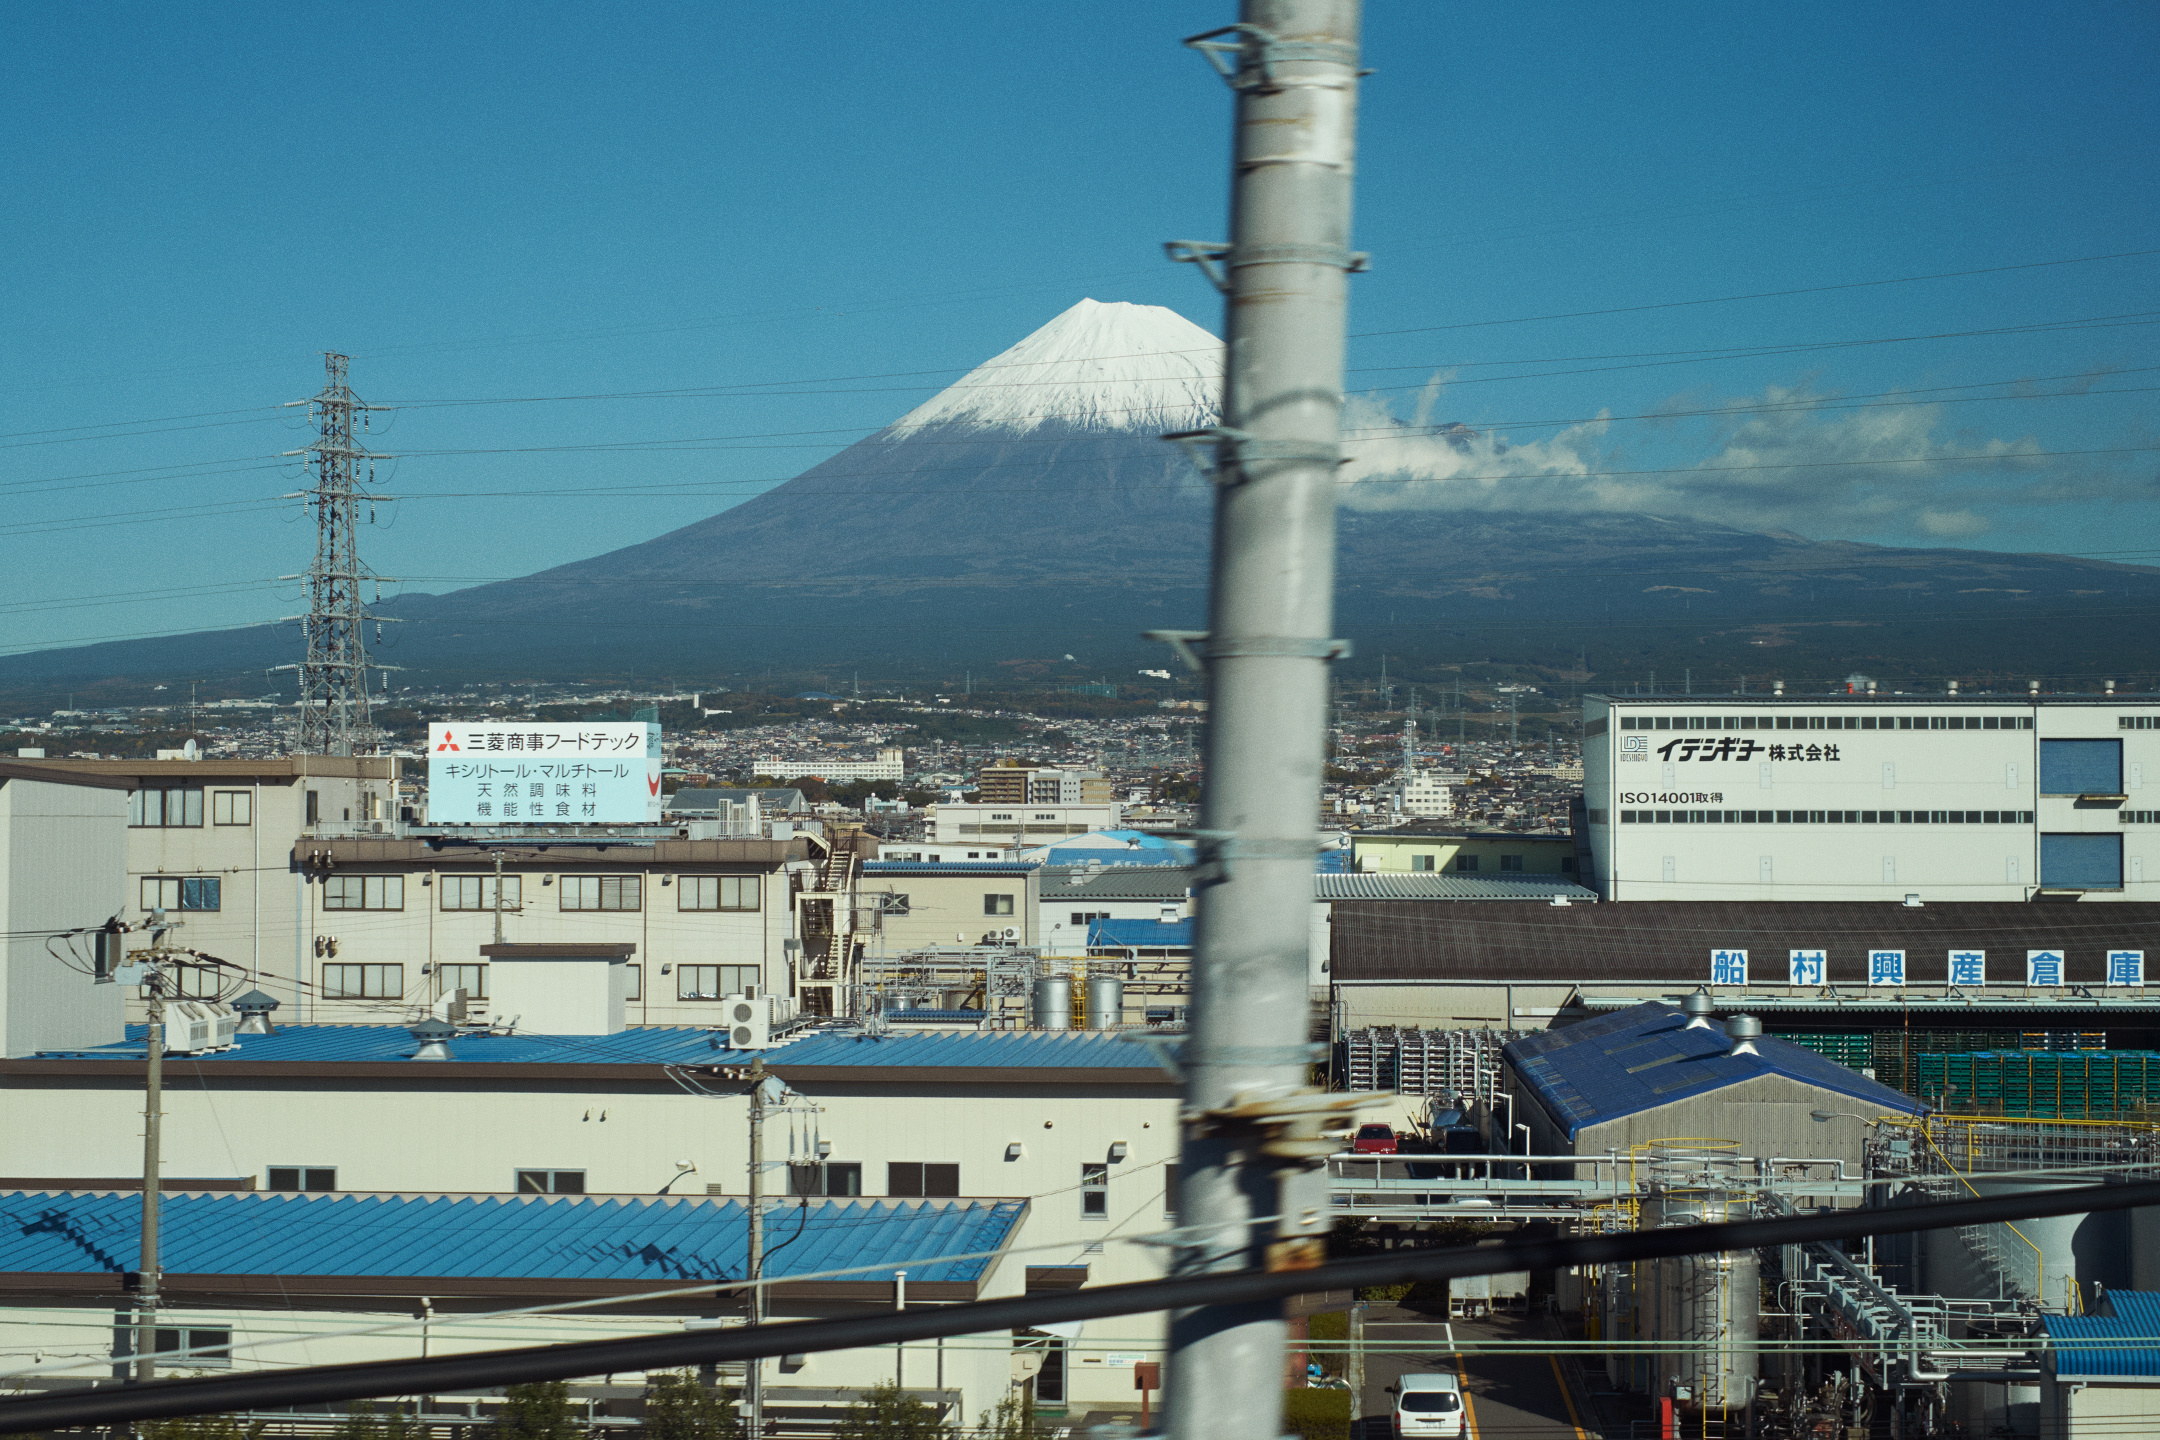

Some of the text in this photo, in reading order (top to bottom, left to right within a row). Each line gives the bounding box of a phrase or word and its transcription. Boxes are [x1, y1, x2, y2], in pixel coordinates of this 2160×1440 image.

[467, 732, 639, 751] 三菱商事フードテック
[446, 764, 629, 778] キシリトール・マルチトール
[478, 783, 597, 797] 天然調味料
[477, 802, 597, 817] 機能性食材
